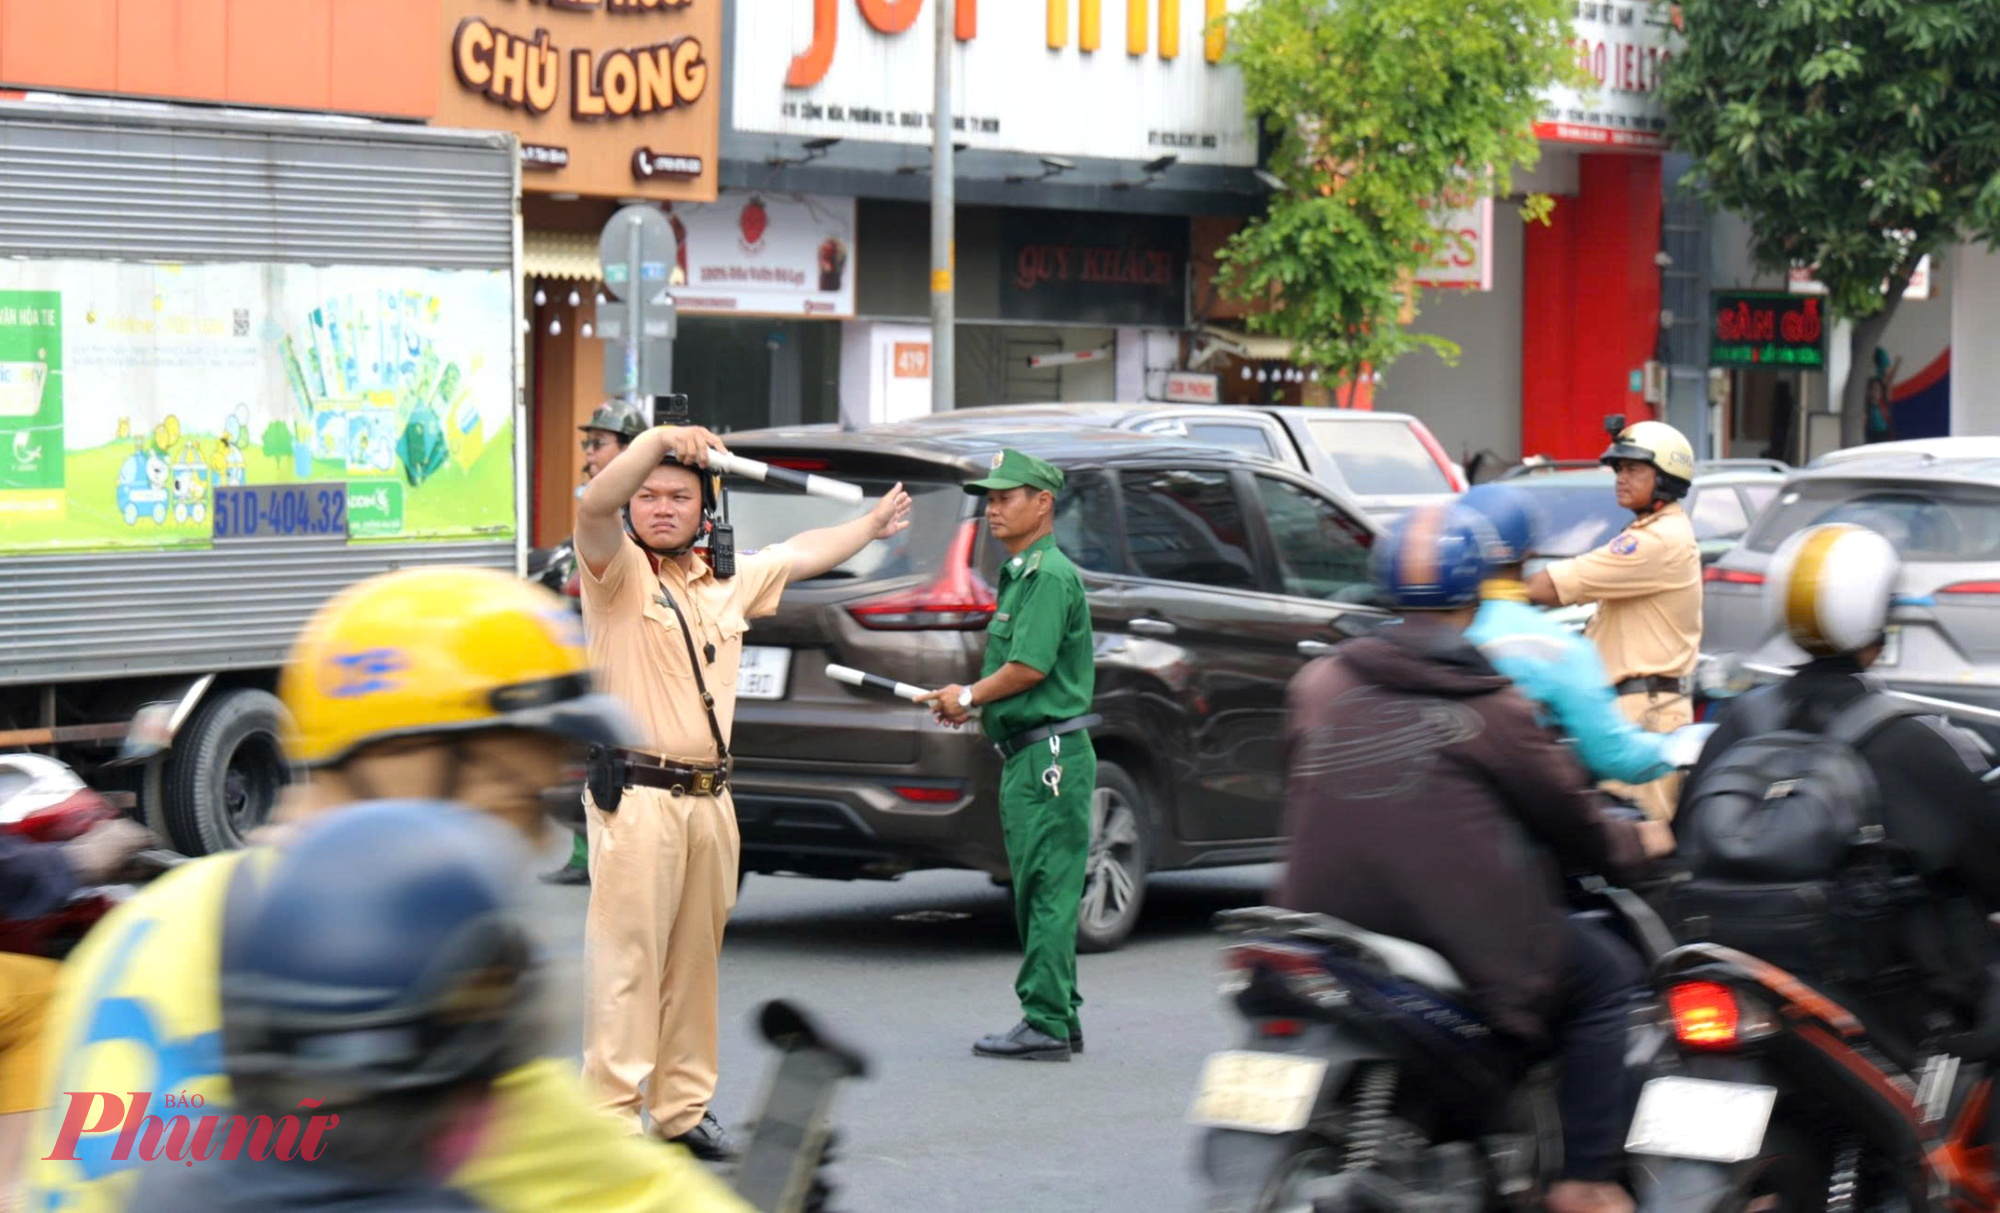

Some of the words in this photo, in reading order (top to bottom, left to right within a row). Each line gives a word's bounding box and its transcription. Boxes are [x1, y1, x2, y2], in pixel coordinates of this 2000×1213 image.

[456, 19, 558, 114] CHÚ
[573, 38, 706, 119] LONG
[214, 489, 345, 536] 51D-404.32
